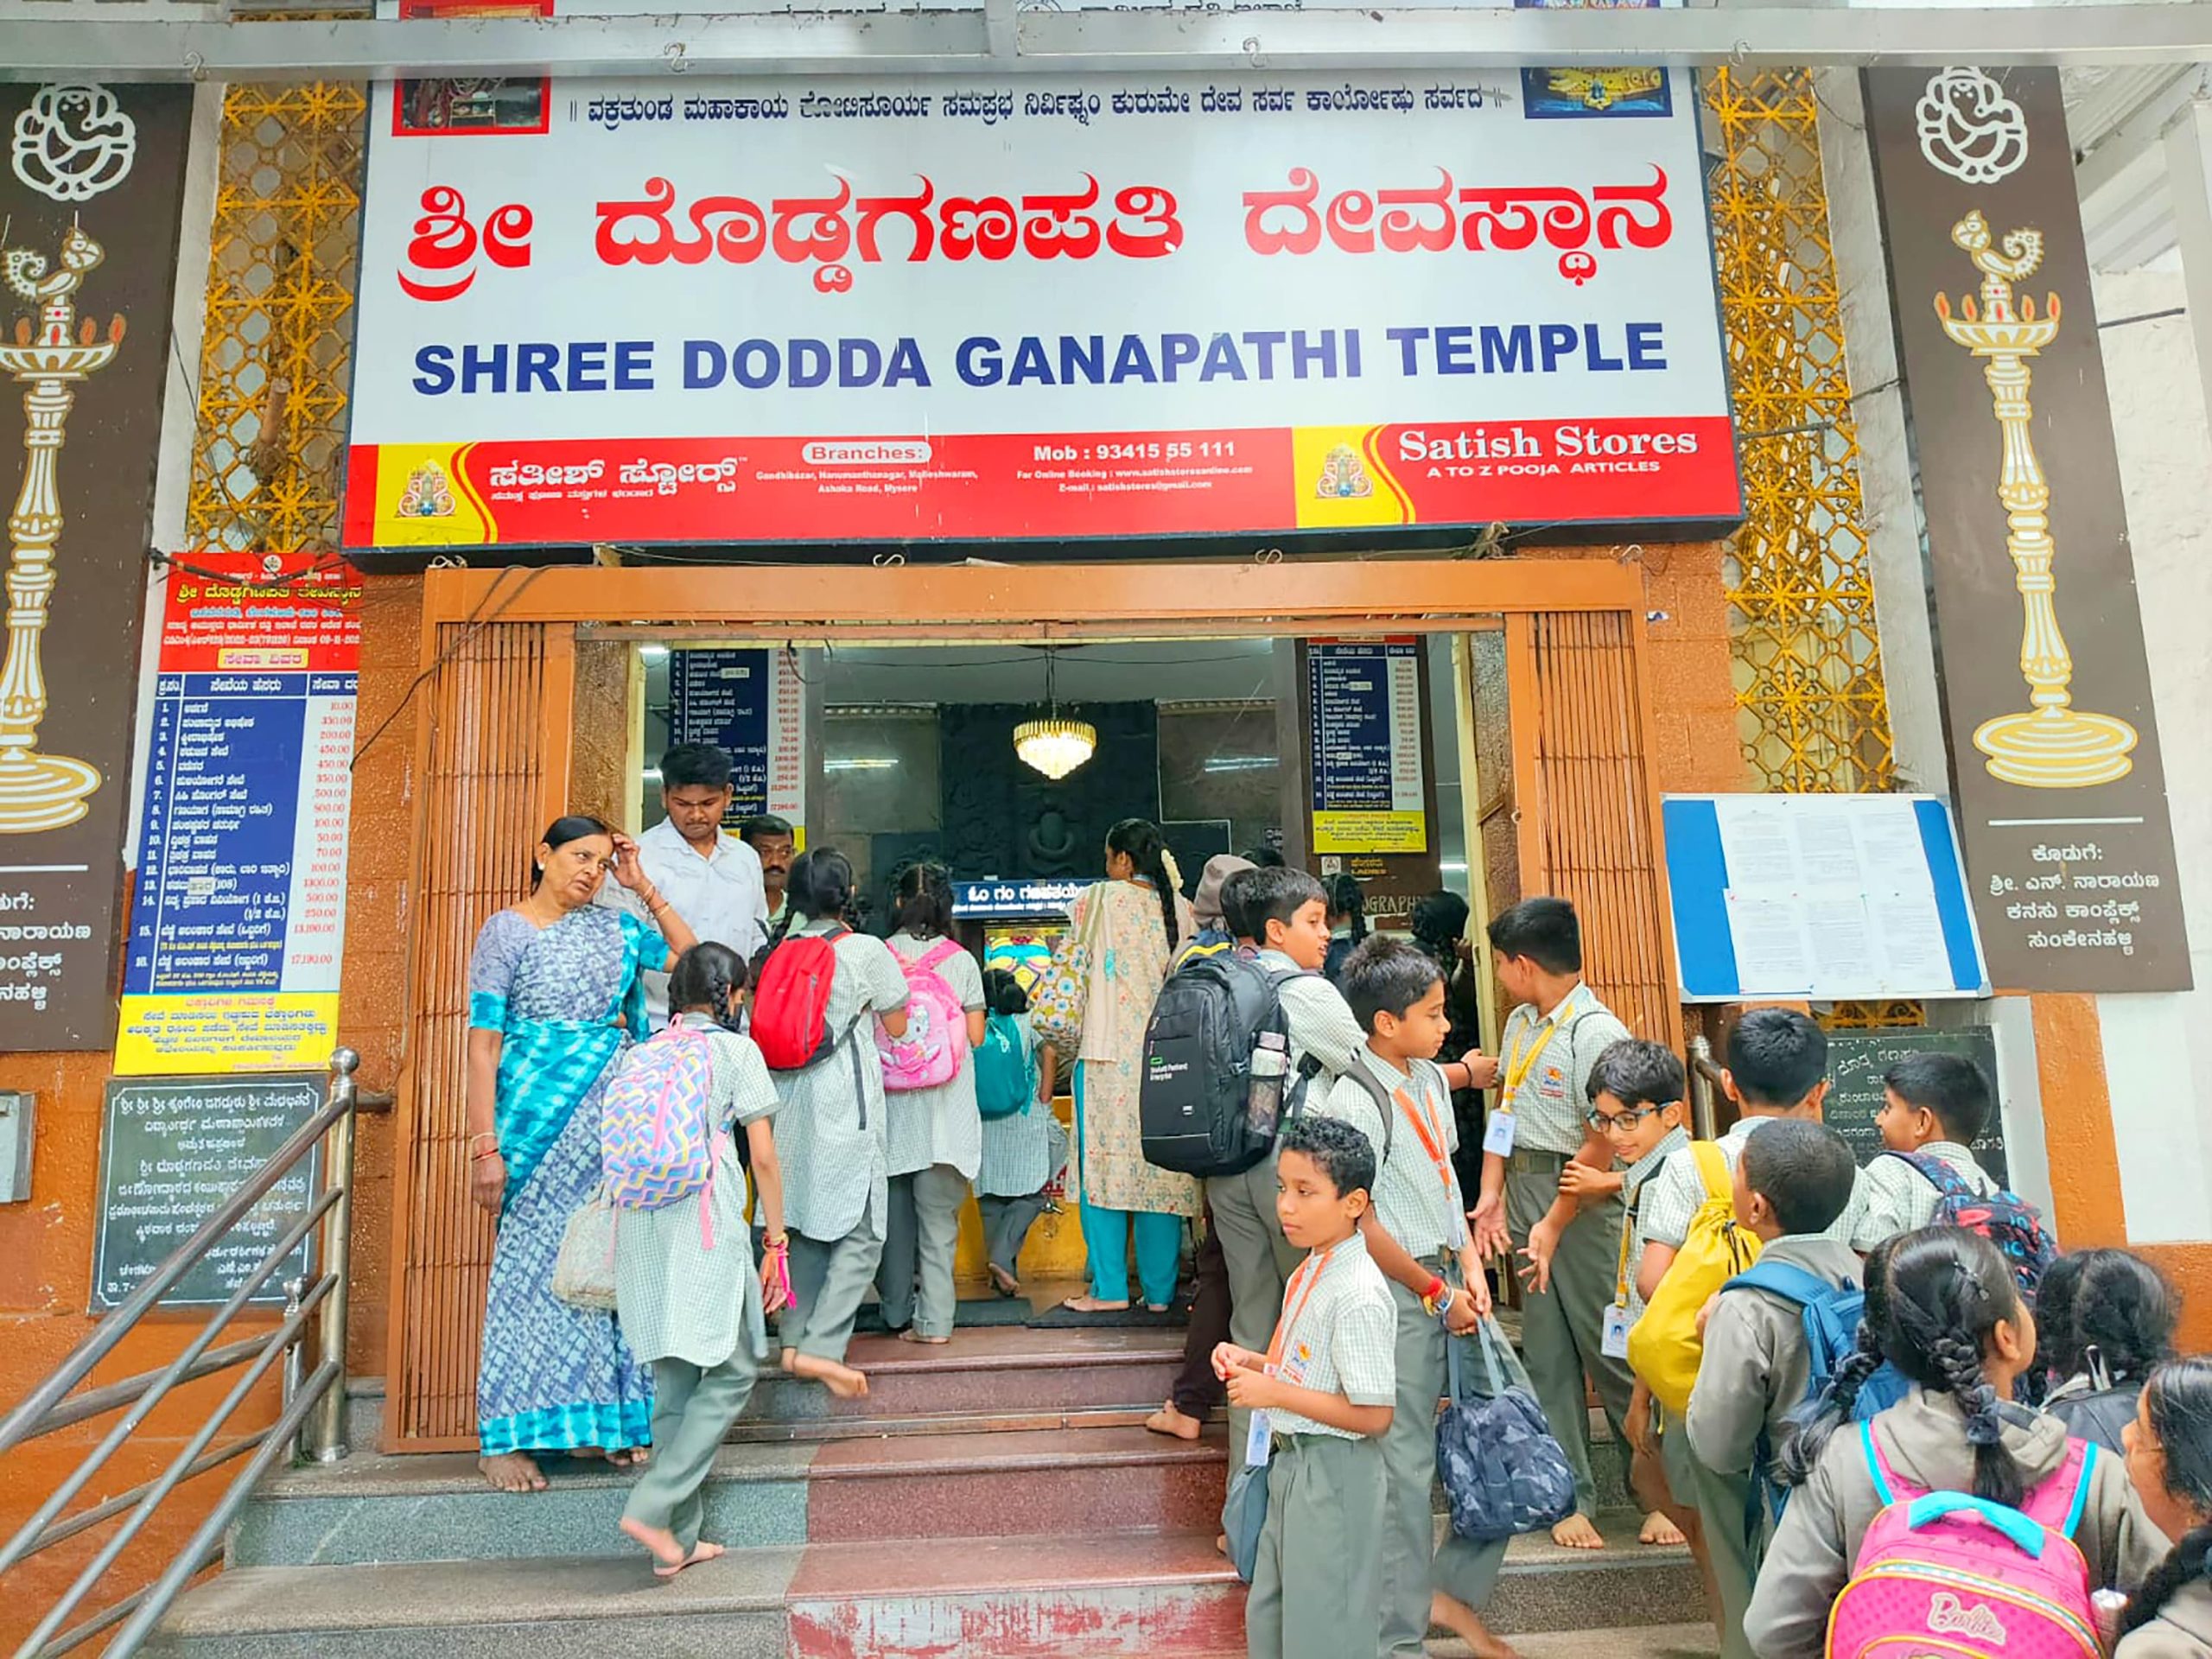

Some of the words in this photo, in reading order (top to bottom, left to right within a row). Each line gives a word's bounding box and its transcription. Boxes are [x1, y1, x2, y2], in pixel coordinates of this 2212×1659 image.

[588, 95, 673, 130] ವಕ್ರತುಂಡ
[683, 92, 789, 121] ಮಹಾಕಾಯ
[944, 89, 1014, 125] ಸಮಪ್ರಭ
[1112, 86, 1191, 114] ಕುರುಮೇ
[1201, 85, 1243, 112] ದೇವ
[1253, 85, 1294, 112] ಸರ್ವ
[1425, 85, 1483, 111] ಸರ್ವದ
[397, 184, 534, 302] ಶ್ರೀ
[594, 172, 1184, 294] ದೊಡ್ಡಗಣಪತಿ
[1242, 162, 1672, 287] ದೇವಸ್ಥಾನ
[412, 341, 655, 395] SHREE
[683, 337, 931, 390] DODDA
[955, 328, 1363, 387] GANAPATHI
[1386, 321, 1668, 377] TEMPLE
[1033, 445, 1077, 461] Mob
[1096, 443, 1160, 460] 93415
[1166, 442, 1192, 459] 55
[1199, 442, 1235, 457] 111
[1399, 426, 1542, 461] Satish
[1554, 425, 1699, 457] Stores
[811, 446, 923, 461] Branches:
[489, 459, 605, 486] ಸತೀಶ್
[1427, 467, 1443, 479] A
[1445, 467, 1473, 478] TO
[1478, 467, 1492, 477] Z
[1497, 464, 1560, 478] POOJA
[1571, 461, 1660, 474] ARTICLES
[176, 584, 198, 604] ಶ್ರೀ
[2031, 842, 2103, 861] ಕೊಡುಗೆ:
[2073, 871, 2160, 890] ನಾರಾಯಣ
[2006, 901, 2058, 919] ಕನಸು
[1928, 1592, 2006, 1646] Barbie
